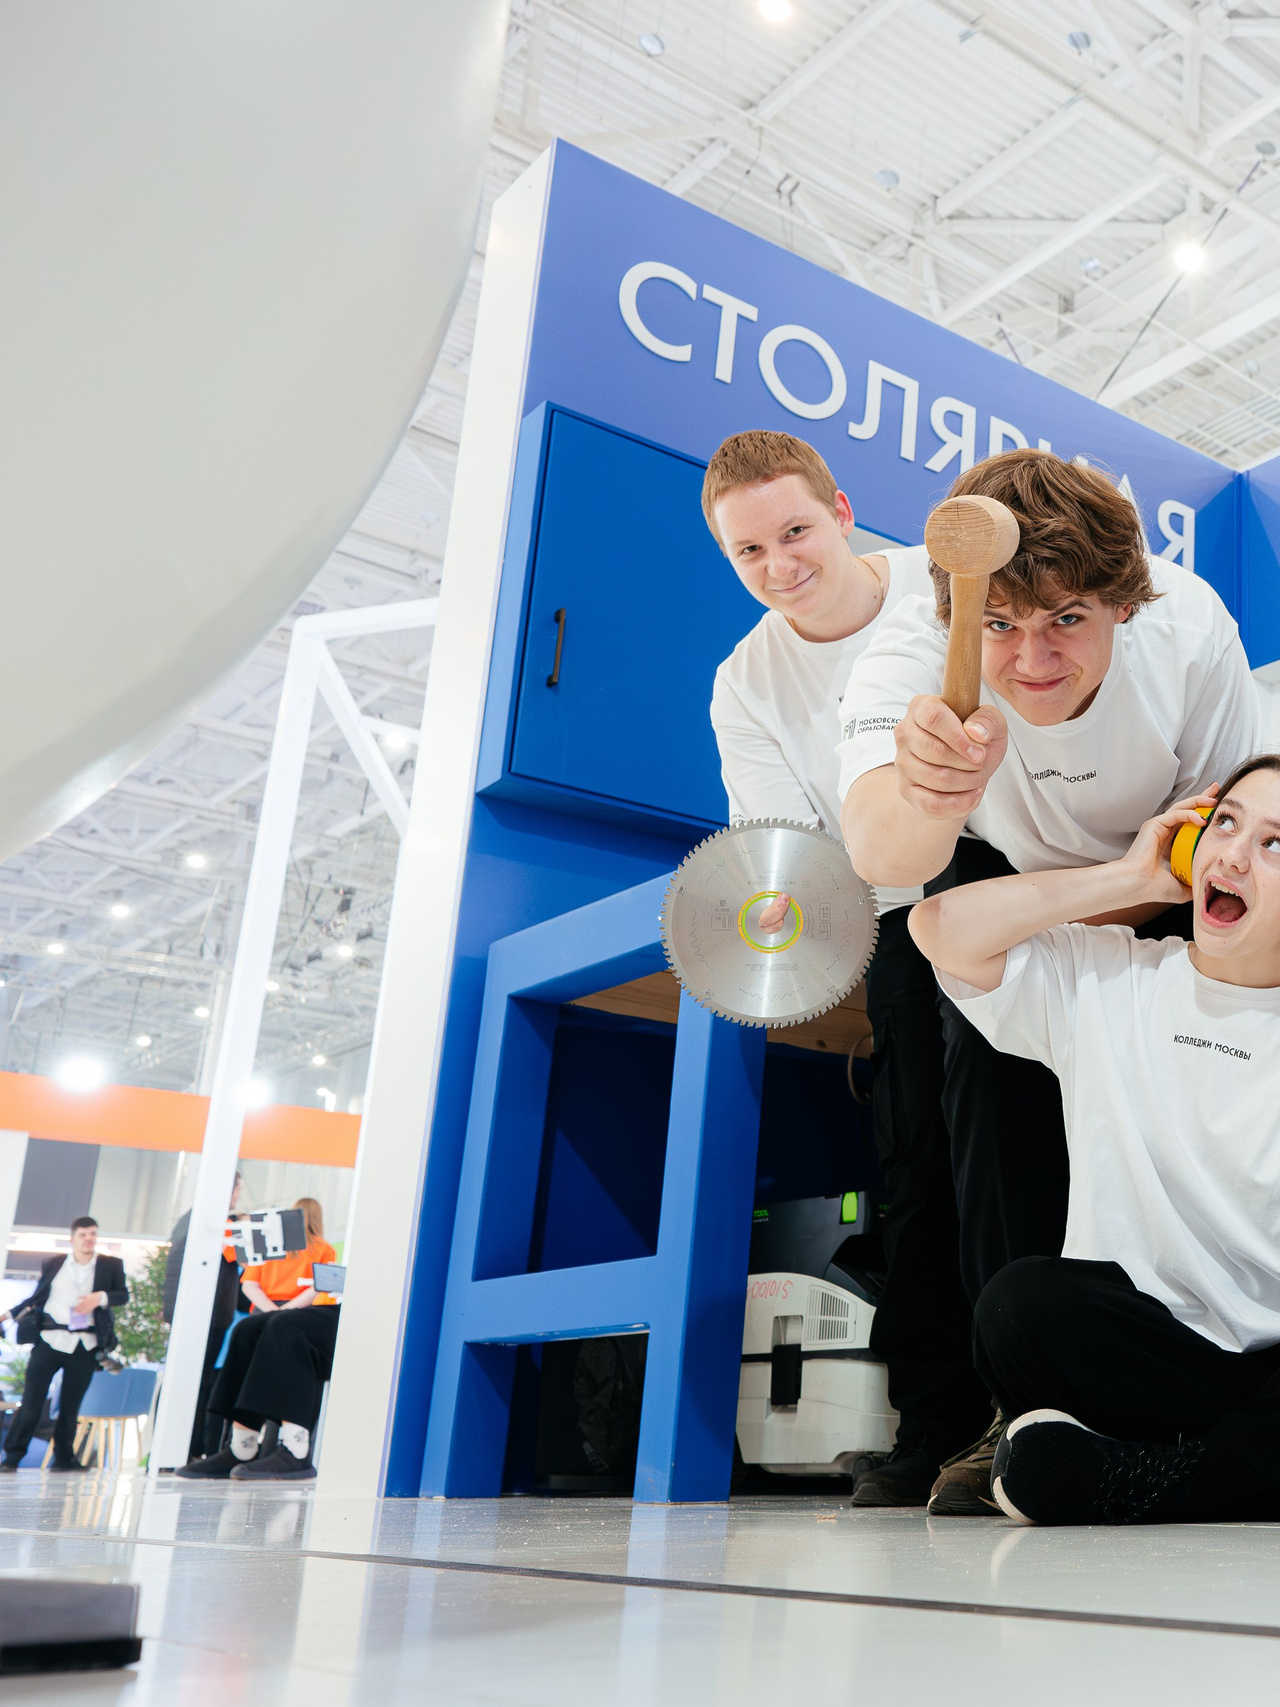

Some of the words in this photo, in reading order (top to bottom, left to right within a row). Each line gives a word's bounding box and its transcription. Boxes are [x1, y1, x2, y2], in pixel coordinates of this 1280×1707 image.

[618, 260, 1196, 571] СТОЛЯРЯ
[1028, 769, 1061, 780] ОЛЛЕДЖИ
[1173, 1034, 1213, 1049] КОЛЛЕДЖИ
[1214, 1042, 1252, 1060] МОСКВЫ
